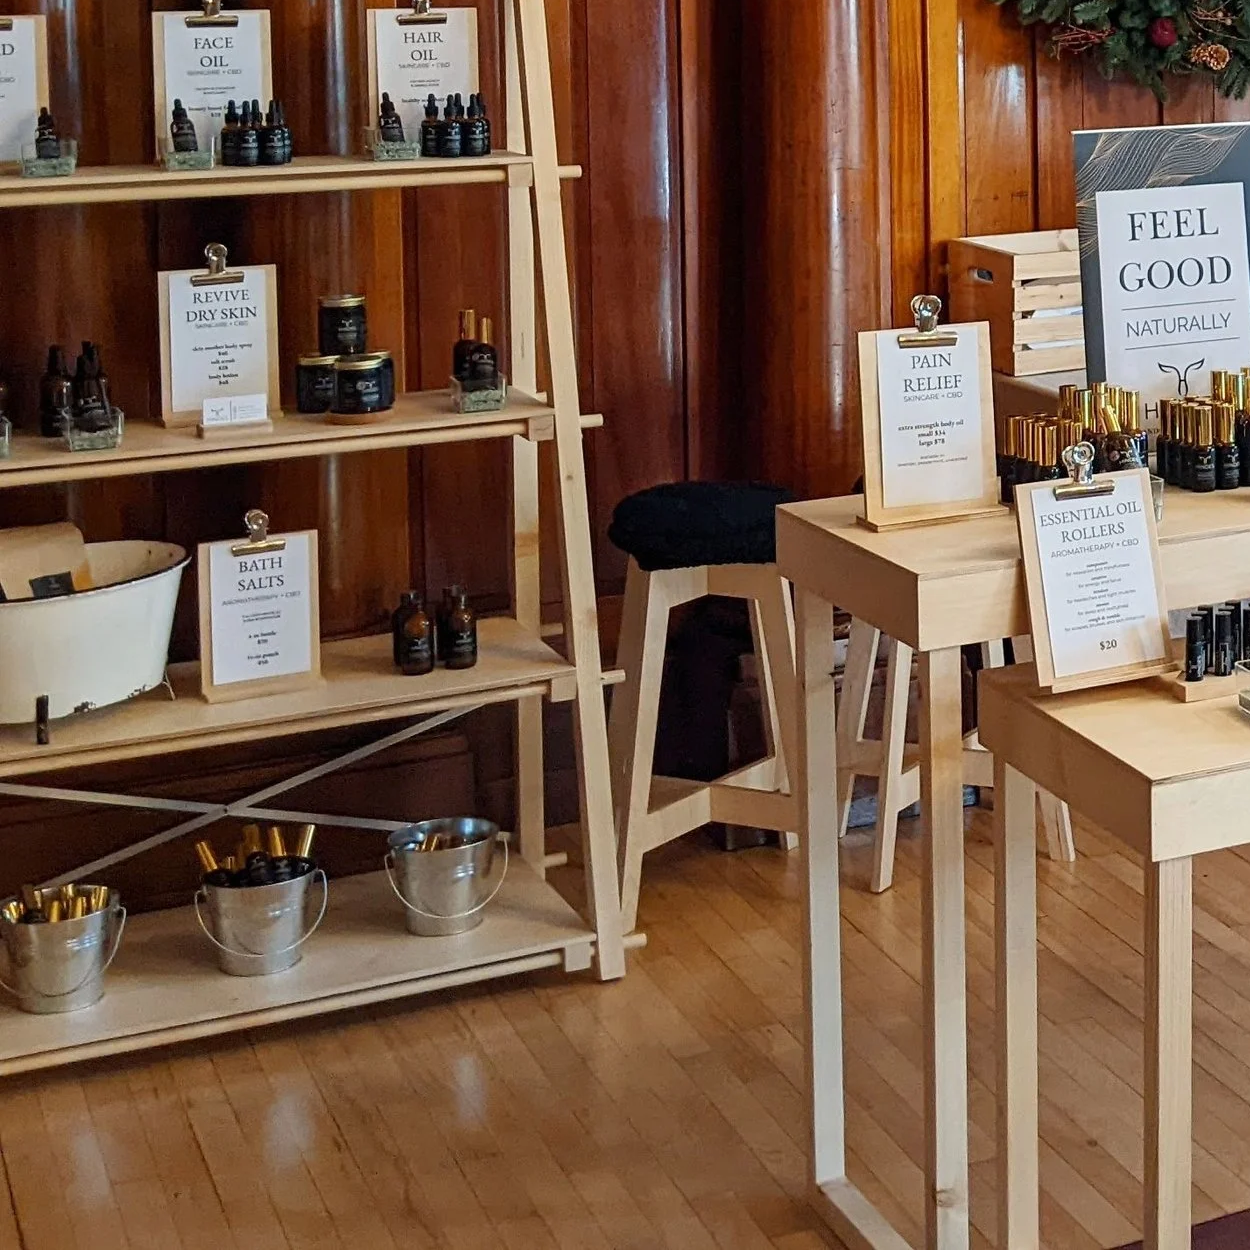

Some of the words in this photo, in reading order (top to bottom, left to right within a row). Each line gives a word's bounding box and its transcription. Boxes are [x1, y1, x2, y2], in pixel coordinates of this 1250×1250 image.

[194, 37, 234, 50] FACE
[404, 31, 443, 44] HAIR
[200, 55, 229, 68] OIL
[410, 49, 438, 61] OIL
[1128, 207, 1219, 242] FEEL
[1119, 255, 1232, 292] GOOD
[193, 289, 250, 304] REVIVE
[186, 309, 218, 323] DRY
[220, 306, 257, 320] SKIN
[1126, 312, 1232, 338] NATURALLY
[911, 353, 951, 369] PAIN
[904, 374, 962, 392] RELIEF
[904, 393, 940, 402] SKINCARE
[947, 391, 963, 399] CBD
[940, 420, 955, 428] body
[1040, 505, 1115, 527] ESSENTIAL
[1116, 501, 1142, 515] OIL
[1061, 522, 1125, 543] ROLLERS
[1051, 542, 1114, 558] AROMATHERAPY
[1121, 538, 1139, 547] CBD
[239, 557, 282, 572] BATH
[238, 575, 284, 591] SALTS
[1100, 639, 1117, 650] $20
